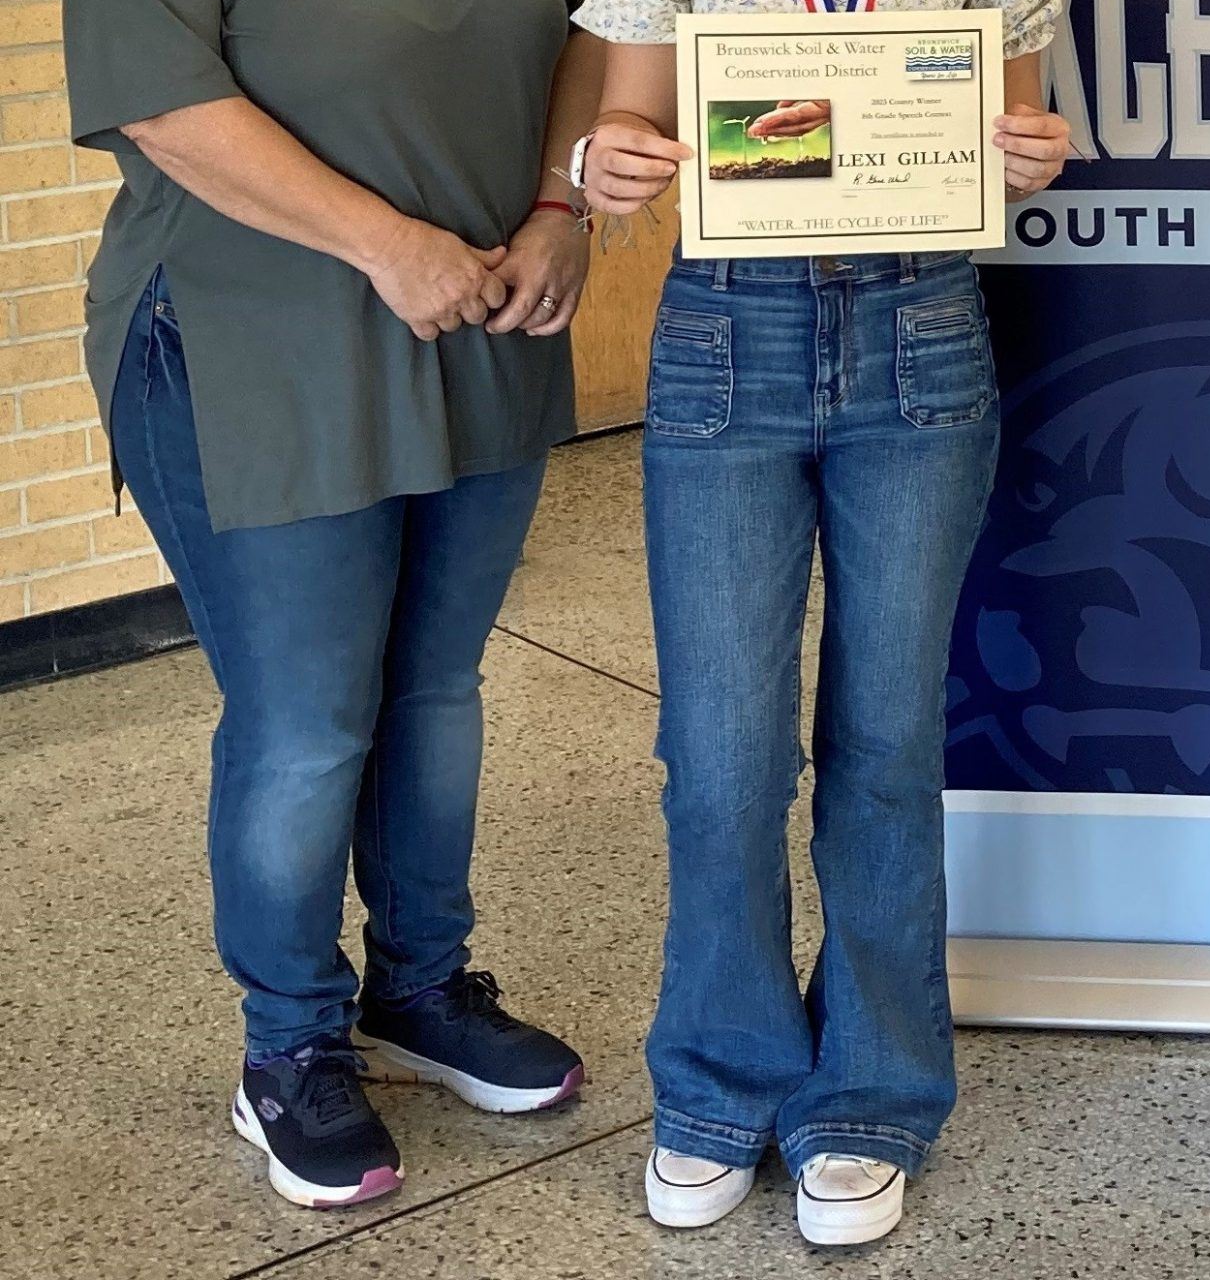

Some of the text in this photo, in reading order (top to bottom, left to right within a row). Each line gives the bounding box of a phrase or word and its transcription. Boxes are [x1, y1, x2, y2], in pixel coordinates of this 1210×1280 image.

[716, 41, 886, 56] Brunswick Soil & Water
[905, 45, 972, 55] SOIL & WATER
[725, 63, 878, 79] Conservation District
[838, 149, 977, 167] LEXI GILLAM
[838, 215, 884, 229] CYCLE
[887, 215, 907, 227] OF
[1004, 206, 1195, 249] OUTH
